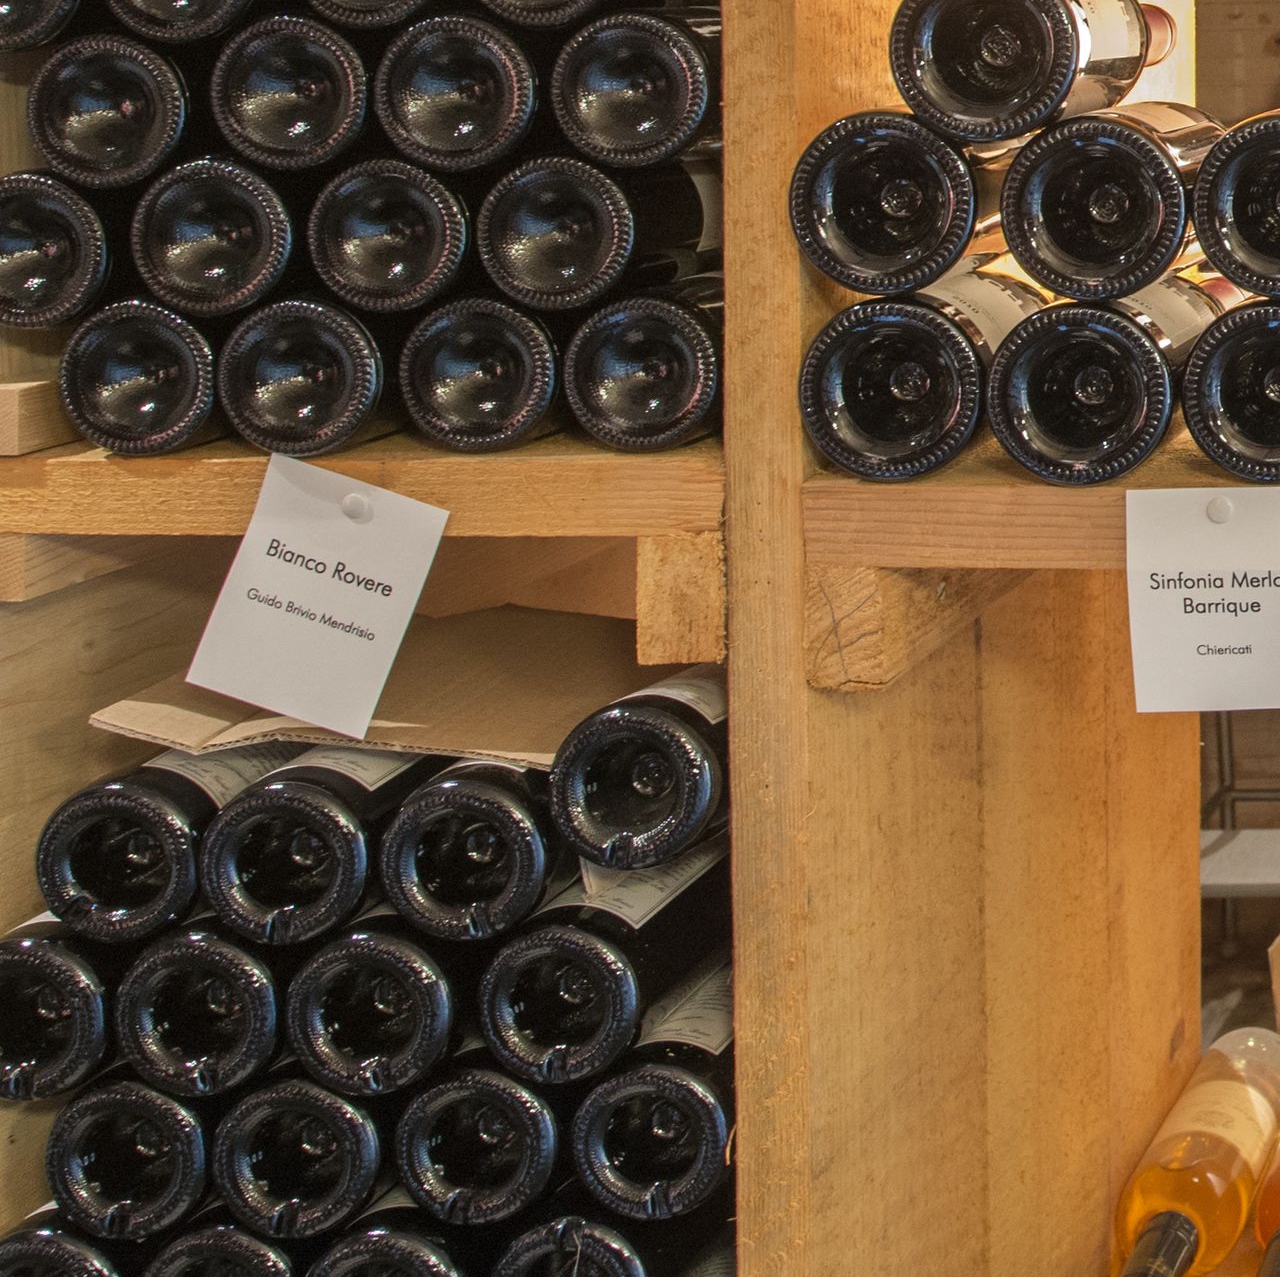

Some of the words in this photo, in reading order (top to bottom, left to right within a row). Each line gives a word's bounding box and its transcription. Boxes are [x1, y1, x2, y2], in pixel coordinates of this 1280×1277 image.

[265, 538, 327, 574] Bianco
[332, 562, 393, 597] Rovere
[1150, 572, 1224, 590] Sinfonia
[247, 587, 283, 610] Guido
[285, 601, 317, 621] Brivio
[319, 612, 376, 641] Mendrisio
[1183, 597, 1262, 617] Barrique
[1196, 643, 1252, 656] Chiericati
